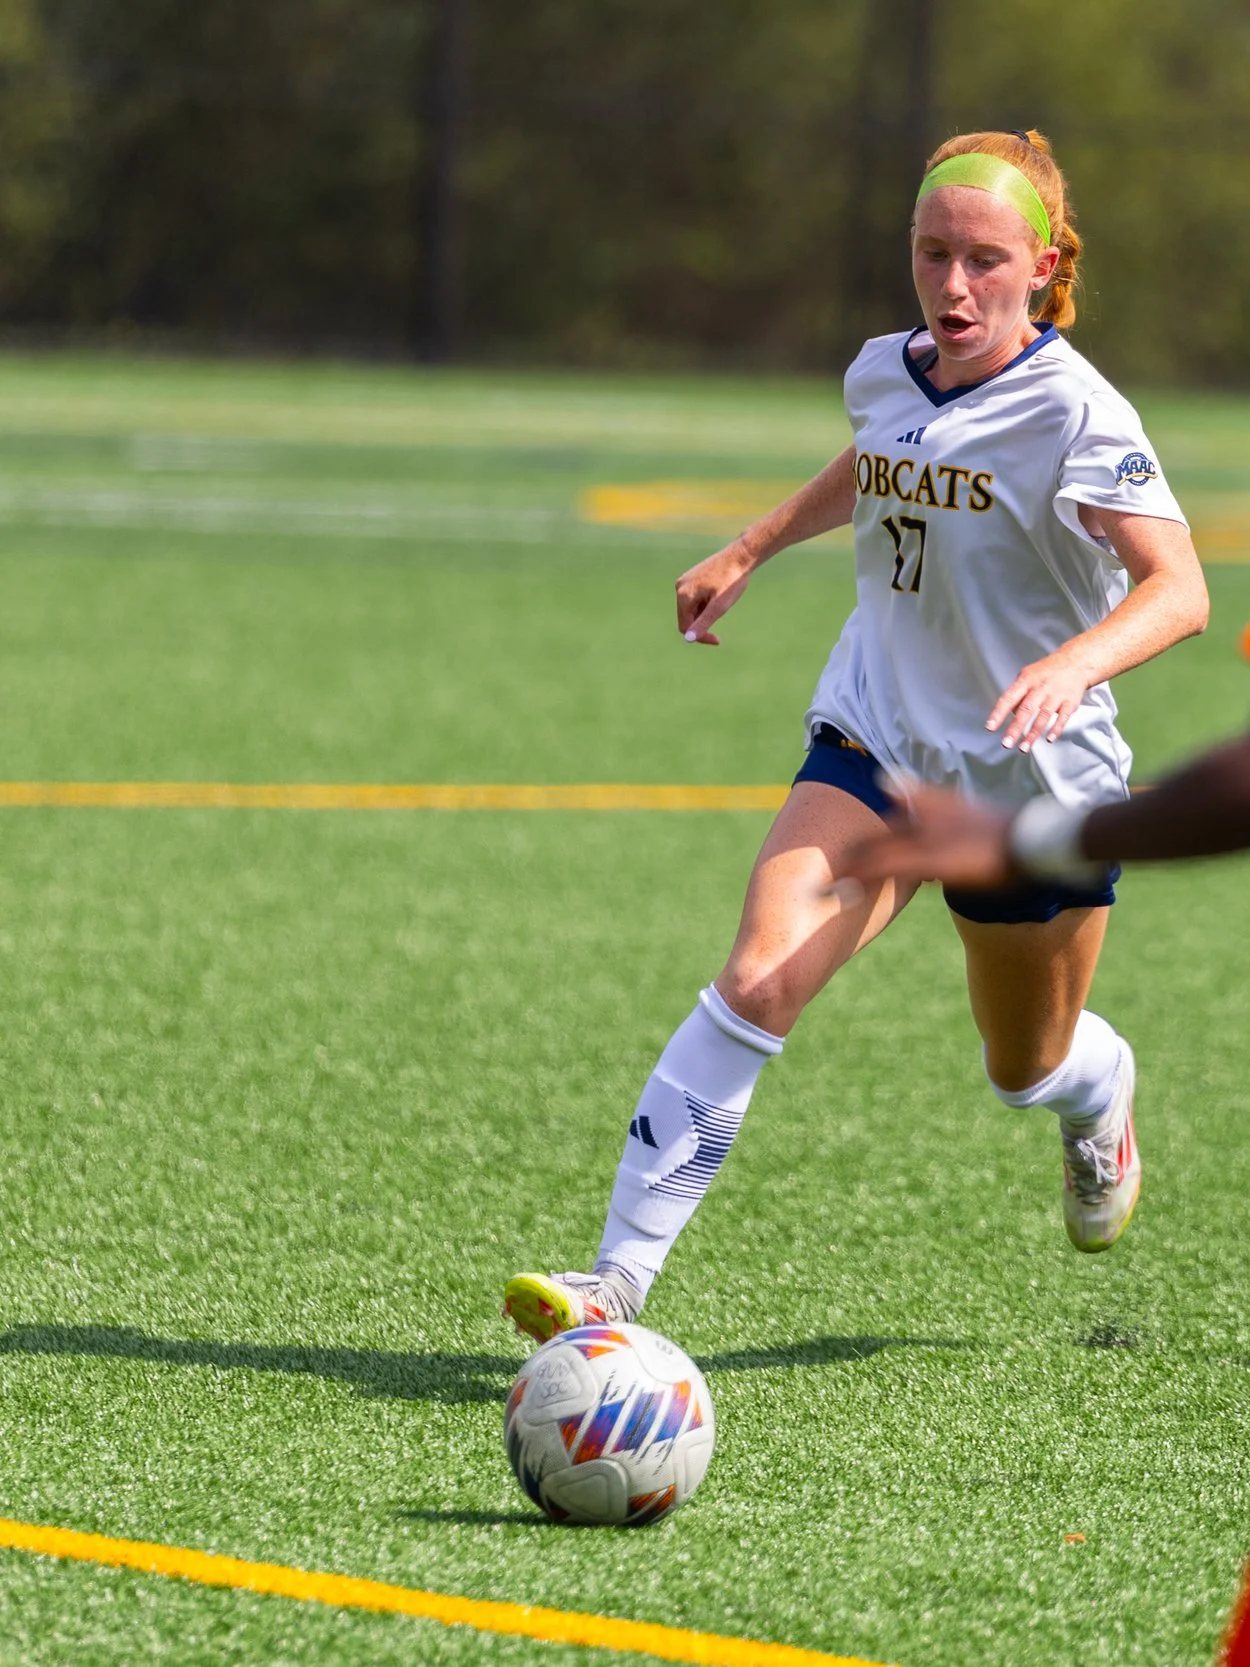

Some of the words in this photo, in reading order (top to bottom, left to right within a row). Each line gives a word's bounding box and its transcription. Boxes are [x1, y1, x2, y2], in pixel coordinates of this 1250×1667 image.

[853, 452, 993, 513] OBCATS
[1115, 459, 1157, 484] MAAC
[881, 514, 927, 594] 17
